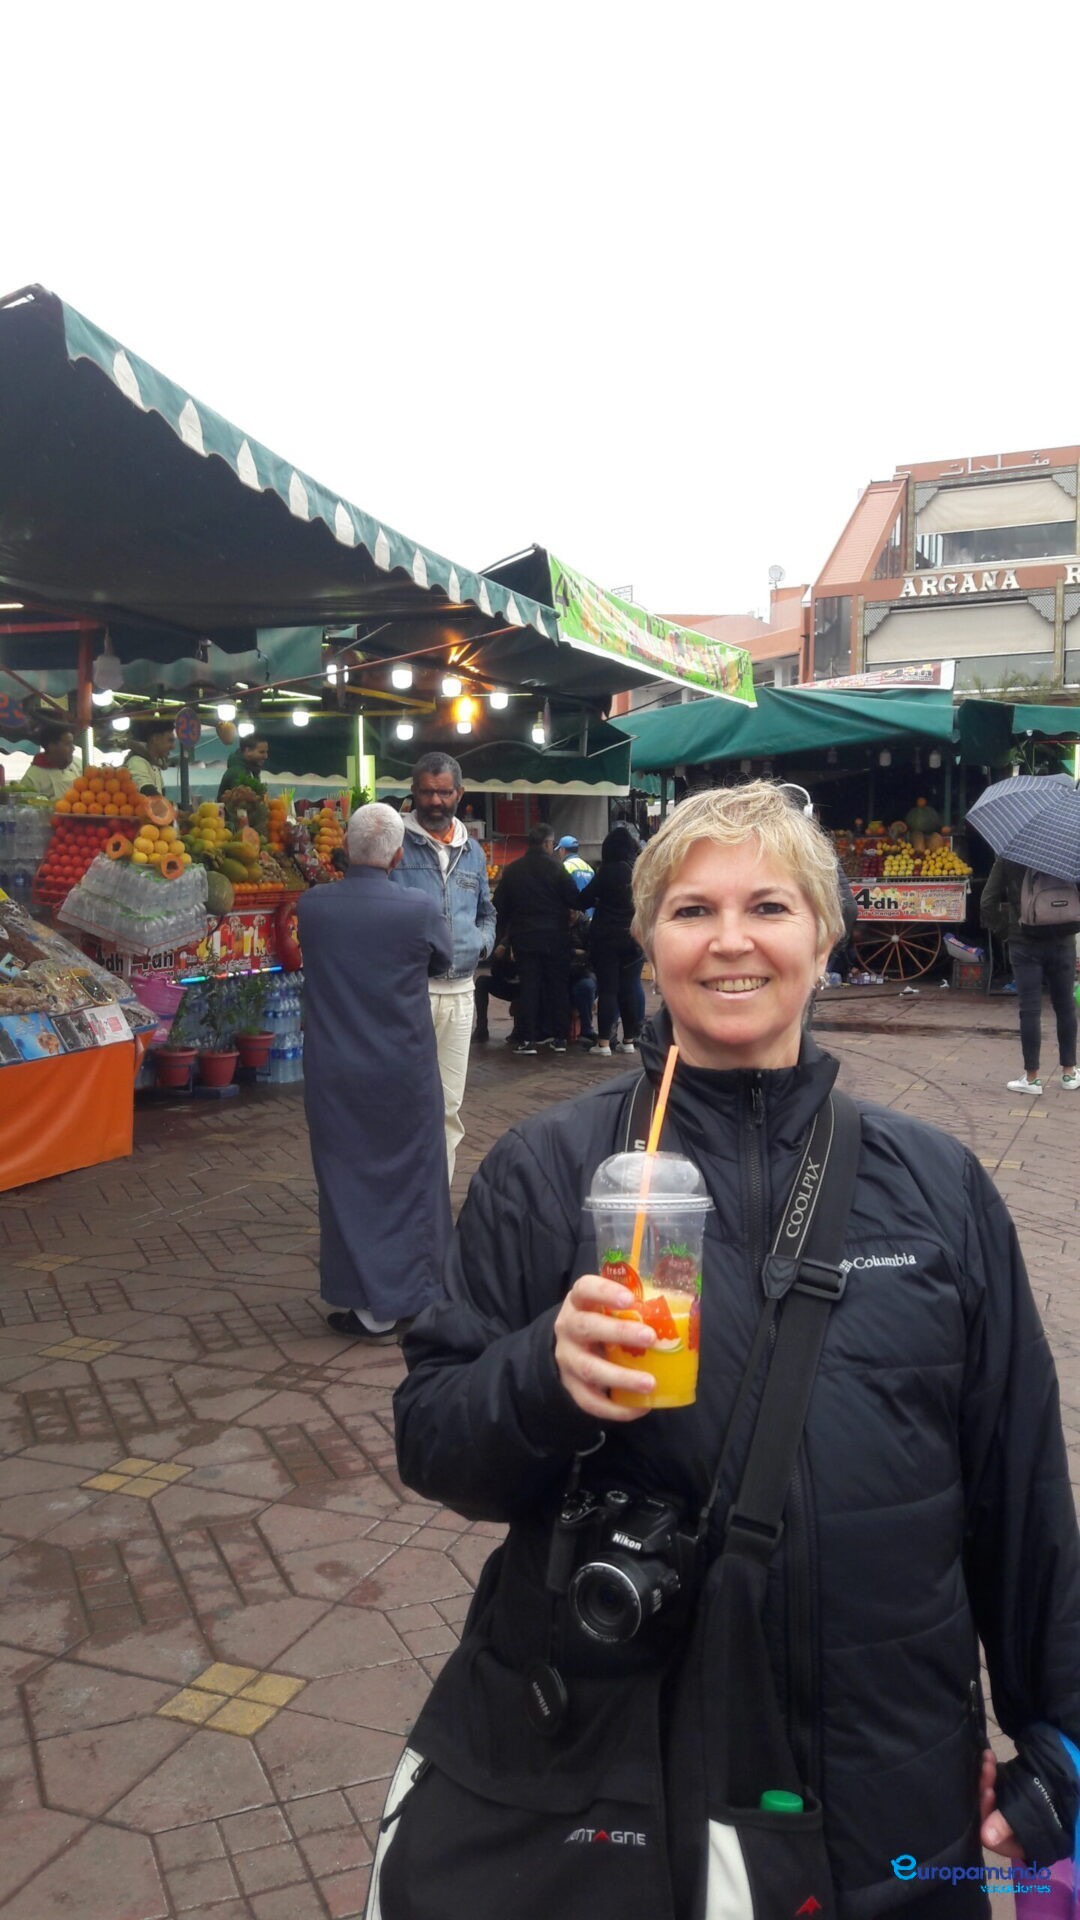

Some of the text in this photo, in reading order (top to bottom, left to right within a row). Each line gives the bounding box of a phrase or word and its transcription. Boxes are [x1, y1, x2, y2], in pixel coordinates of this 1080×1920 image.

[899, 569, 1021, 598] ARGANA
[855, 888, 899, 910] 4dh
[786, 1157, 821, 1239] COOLPIX
[606, 1265, 627, 1275] fresh
[853, 1253, 917, 1269] Columbia
[612, 1532, 643, 1551] Nikon
[532, 1681, 552, 1716] Nikon
